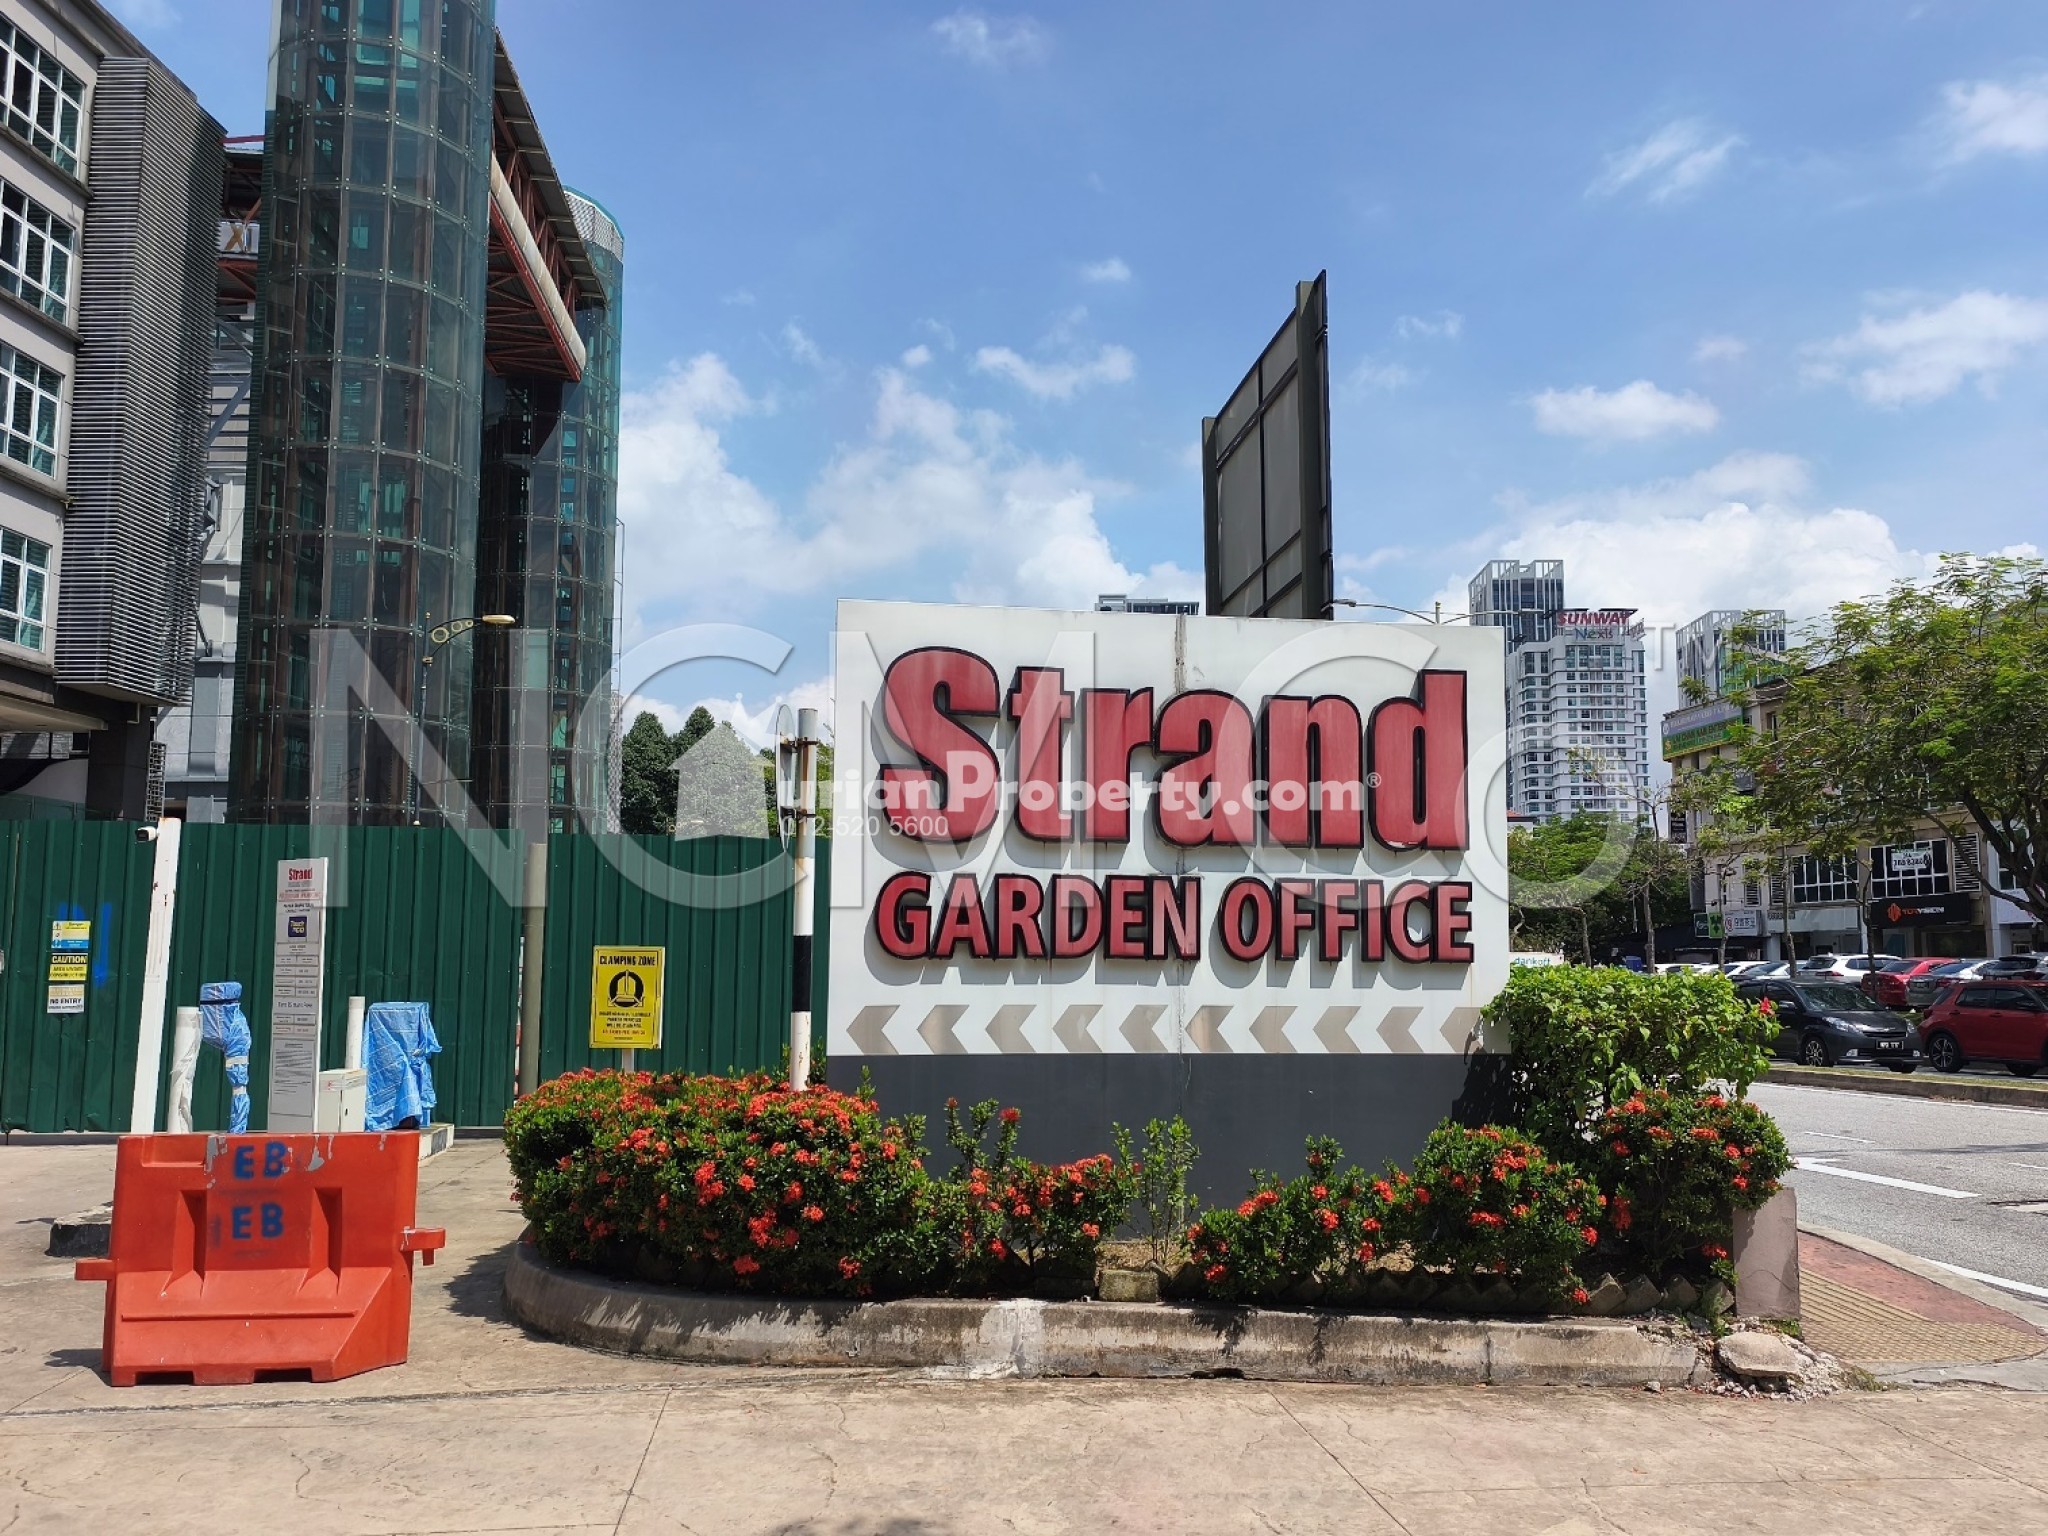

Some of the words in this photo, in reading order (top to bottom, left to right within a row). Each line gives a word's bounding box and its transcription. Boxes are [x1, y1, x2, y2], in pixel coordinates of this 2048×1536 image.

[1557, 611, 1631, 625] SUNWAY
[1574, 628, 1614, 640] Nexis
[880, 646, 1469, 852] Strand
[875, 871, 1201, 962] GARDEN
[1217, 876, 1475, 965] OFFICE
[52, 955, 87, 964] CAUTION
[599, 955, 636, 966] CLAMPING
[638, 955, 656, 966] ZONE
